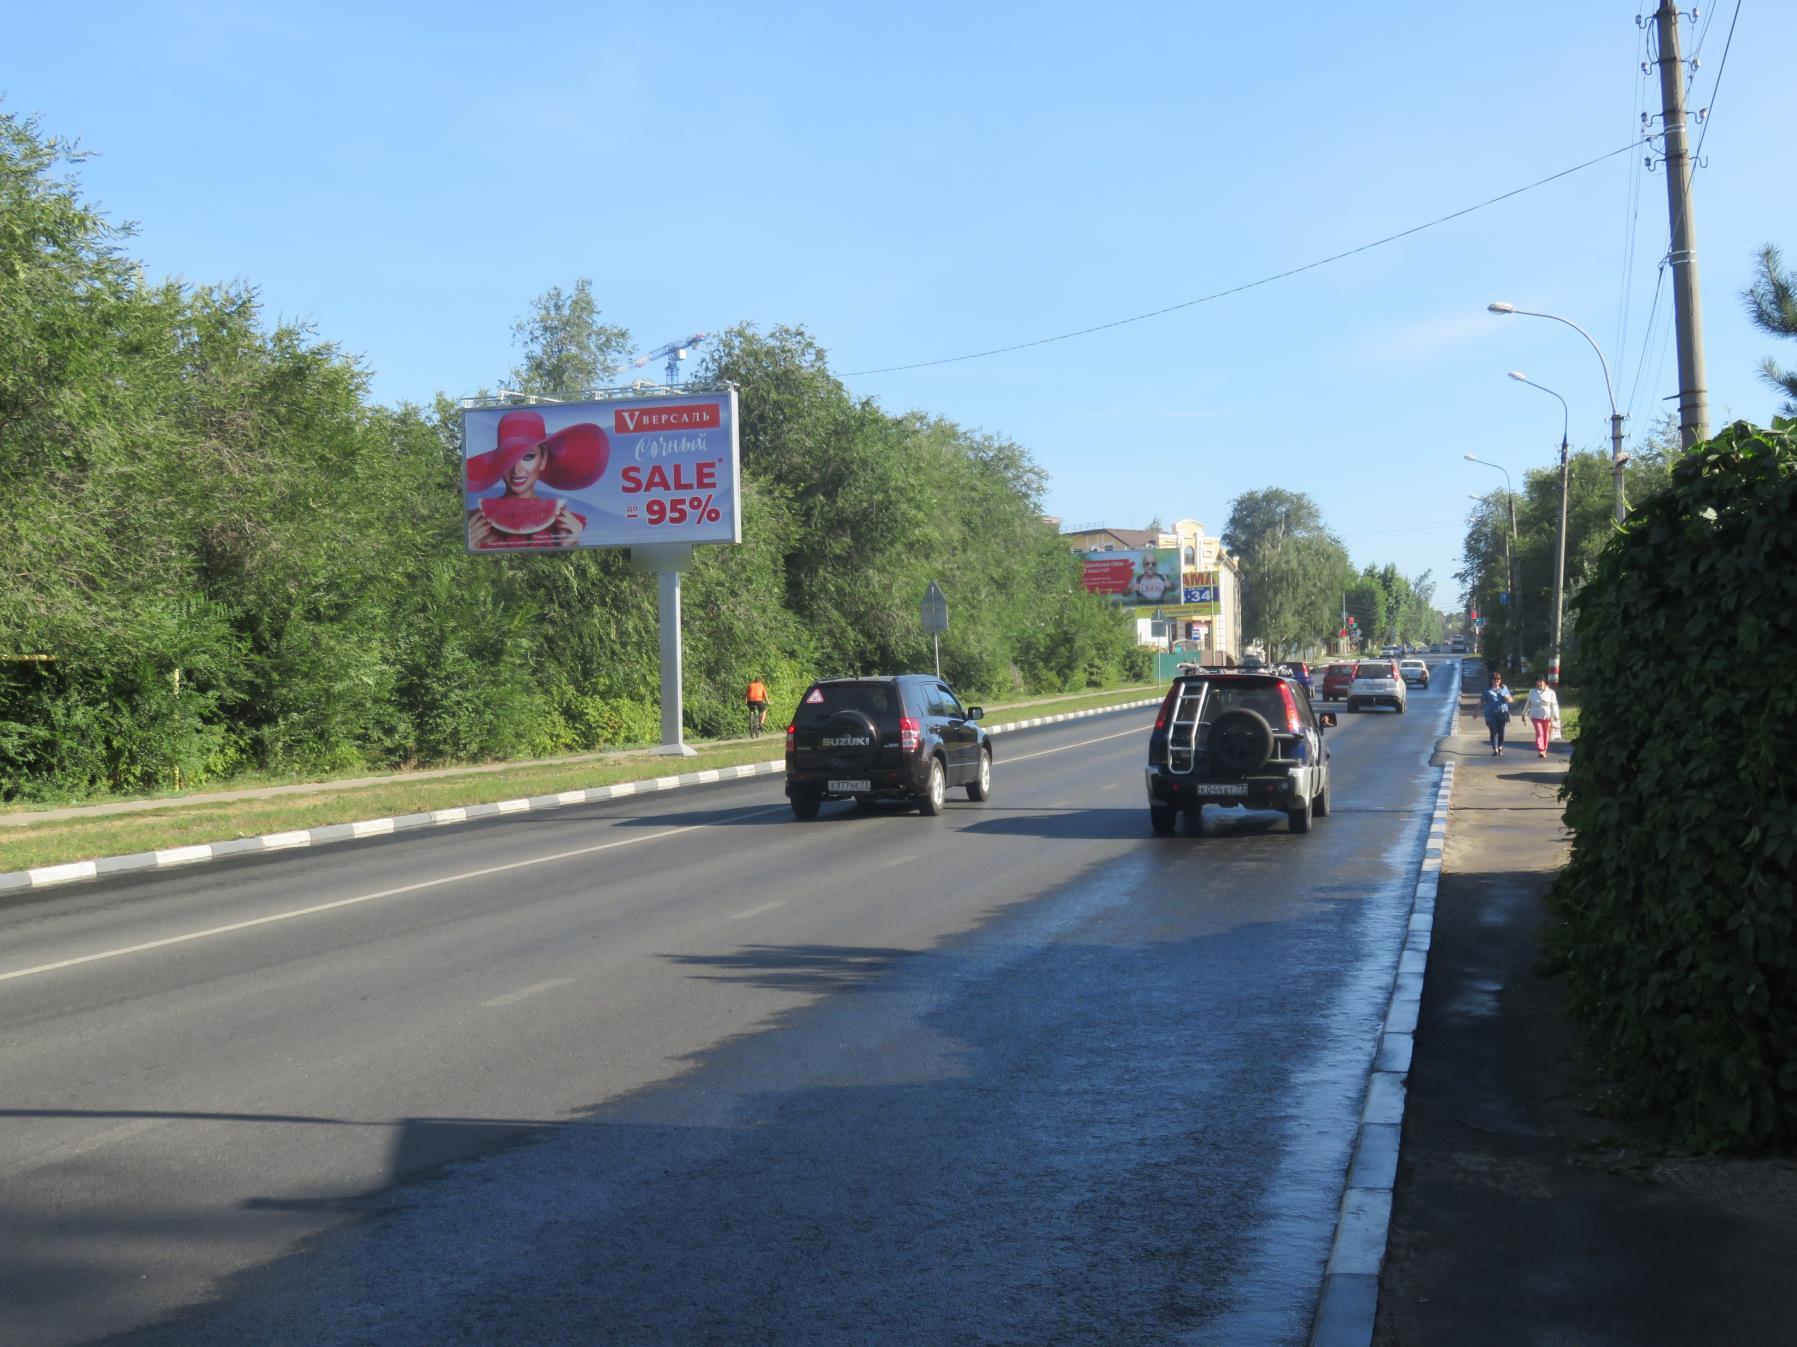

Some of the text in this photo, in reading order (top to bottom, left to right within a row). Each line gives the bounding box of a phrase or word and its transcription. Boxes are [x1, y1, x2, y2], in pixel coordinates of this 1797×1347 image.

[642, 411, 711, 425] ВЕРСАЛЬ
[635, 433, 708, 461] Сочный
[645, 494, 721, 525] 95%
[822, 737, 870, 747] SUZUKI
